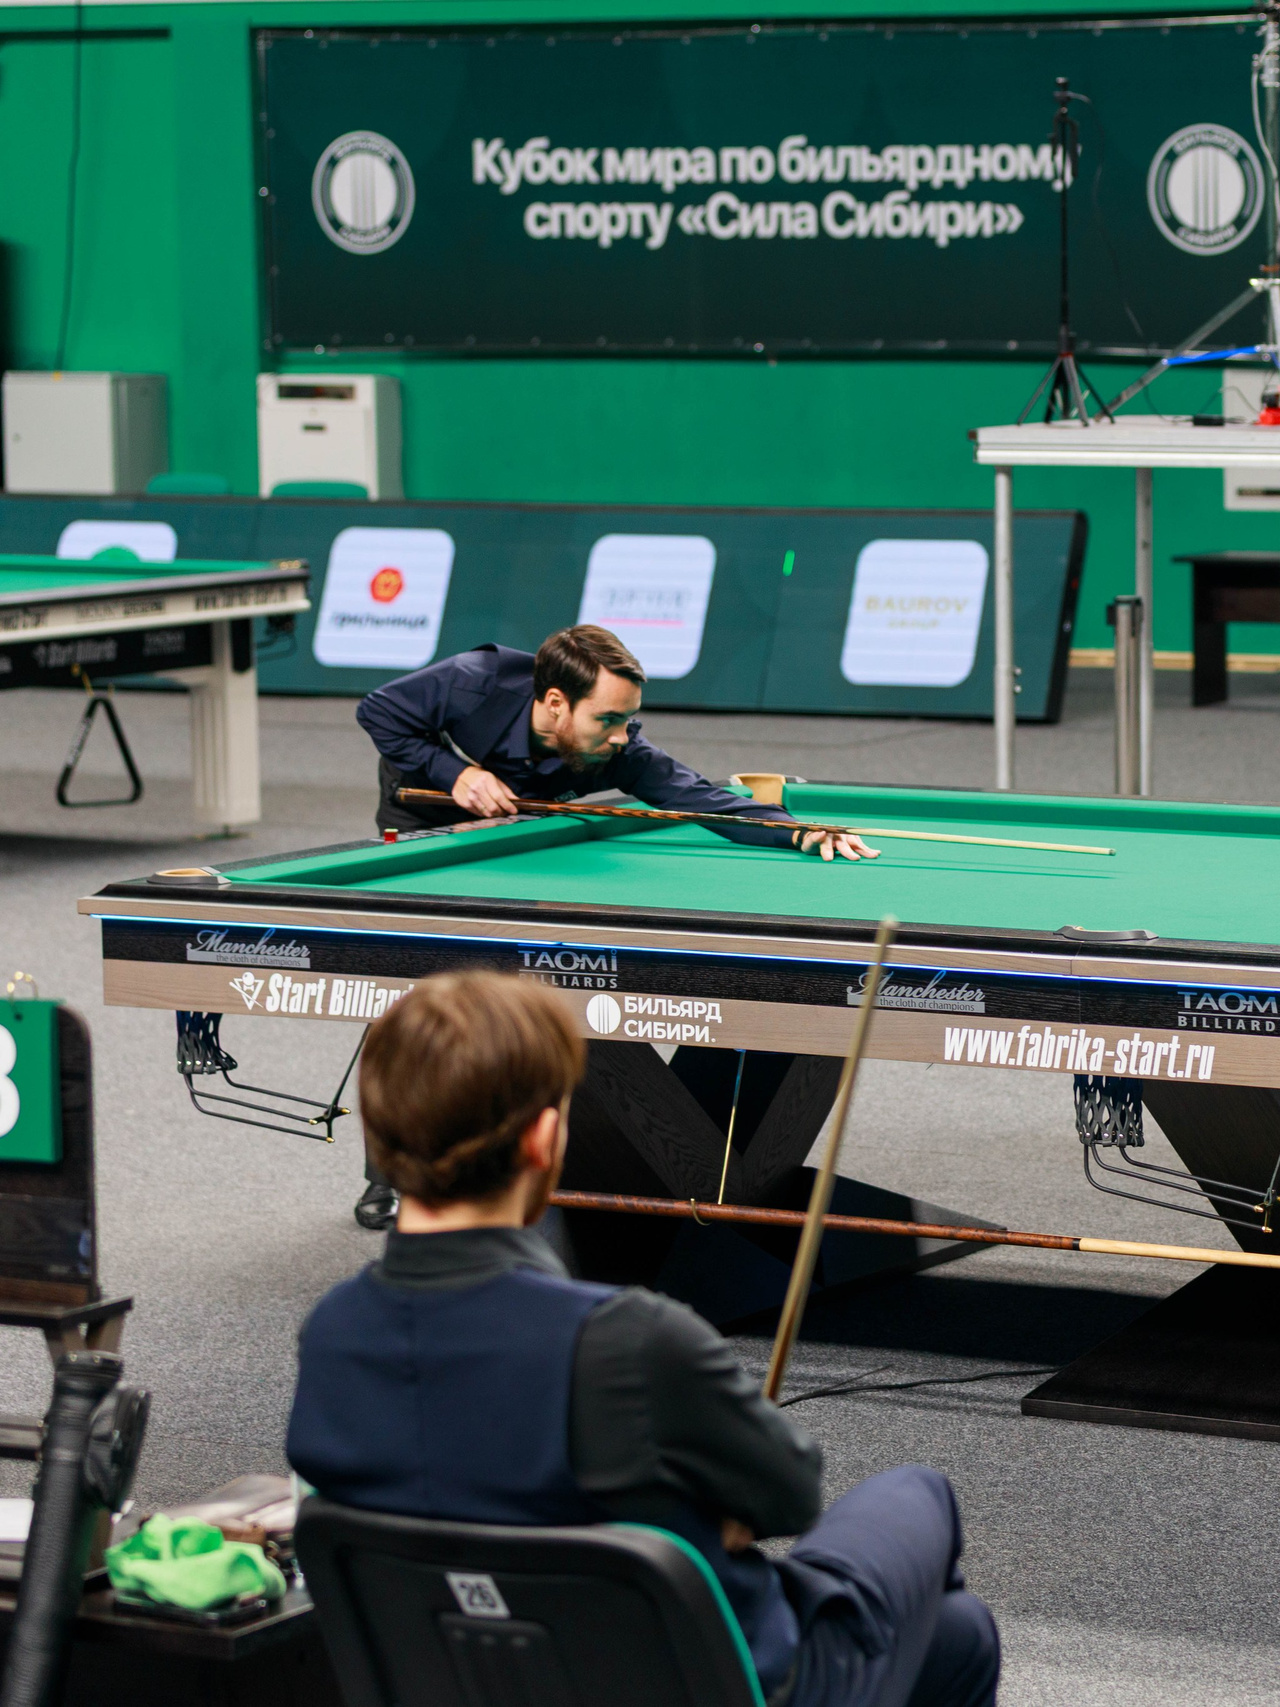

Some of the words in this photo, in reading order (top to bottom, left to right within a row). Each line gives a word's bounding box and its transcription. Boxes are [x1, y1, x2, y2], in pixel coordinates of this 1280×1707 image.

[471, 136, 600, 195] Кубок
[603, 146, 714, 192] мира
[720, 146, 774, 184] по
[524, 200, 673, 249] спорту
[677, 190, 819, 240] «Сила
[821, 190, 1025, 247] Сибири»
[865, 595, 968, 613] BAUROV
[186, 928, 310, 958] Manchester
[266, 972, 327, 1015] Start
[624, 996, 722, 1023] БИЛЬЯРД
[880, 998, 894, 1006] the
[895, 998, 916, 1008] cloth
[917, 1000, 927, 1008] of
[928, 1001, 975, 1011] champions
[944, 1025, 1215, 1080] www.fabrika-start.ru
